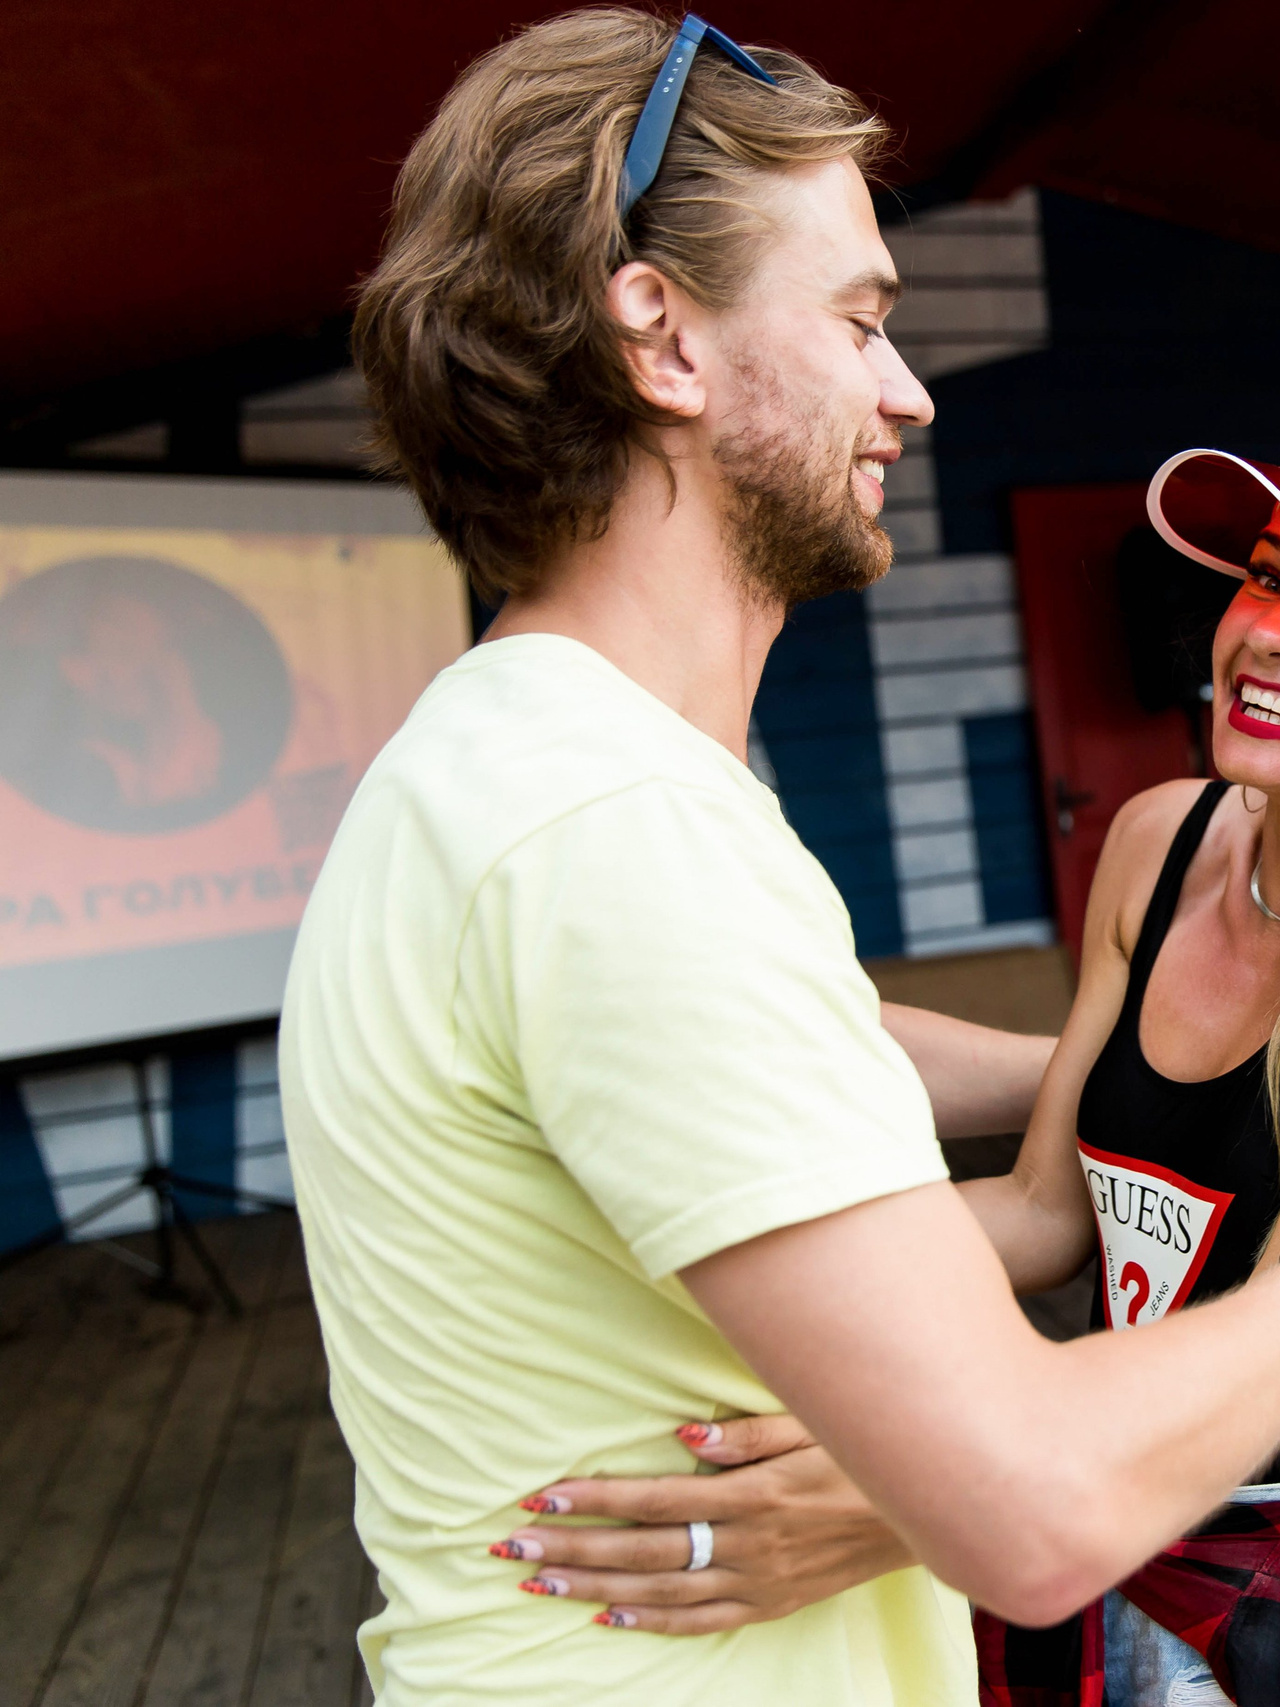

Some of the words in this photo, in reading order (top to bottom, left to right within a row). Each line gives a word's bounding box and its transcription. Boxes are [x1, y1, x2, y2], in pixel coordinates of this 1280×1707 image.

[1087, 1168, 1192, 1254] GUESS
[1106, 1244, 1118, 1301] WASHED
[1149, 1281, 1170, 1317] JEANS
